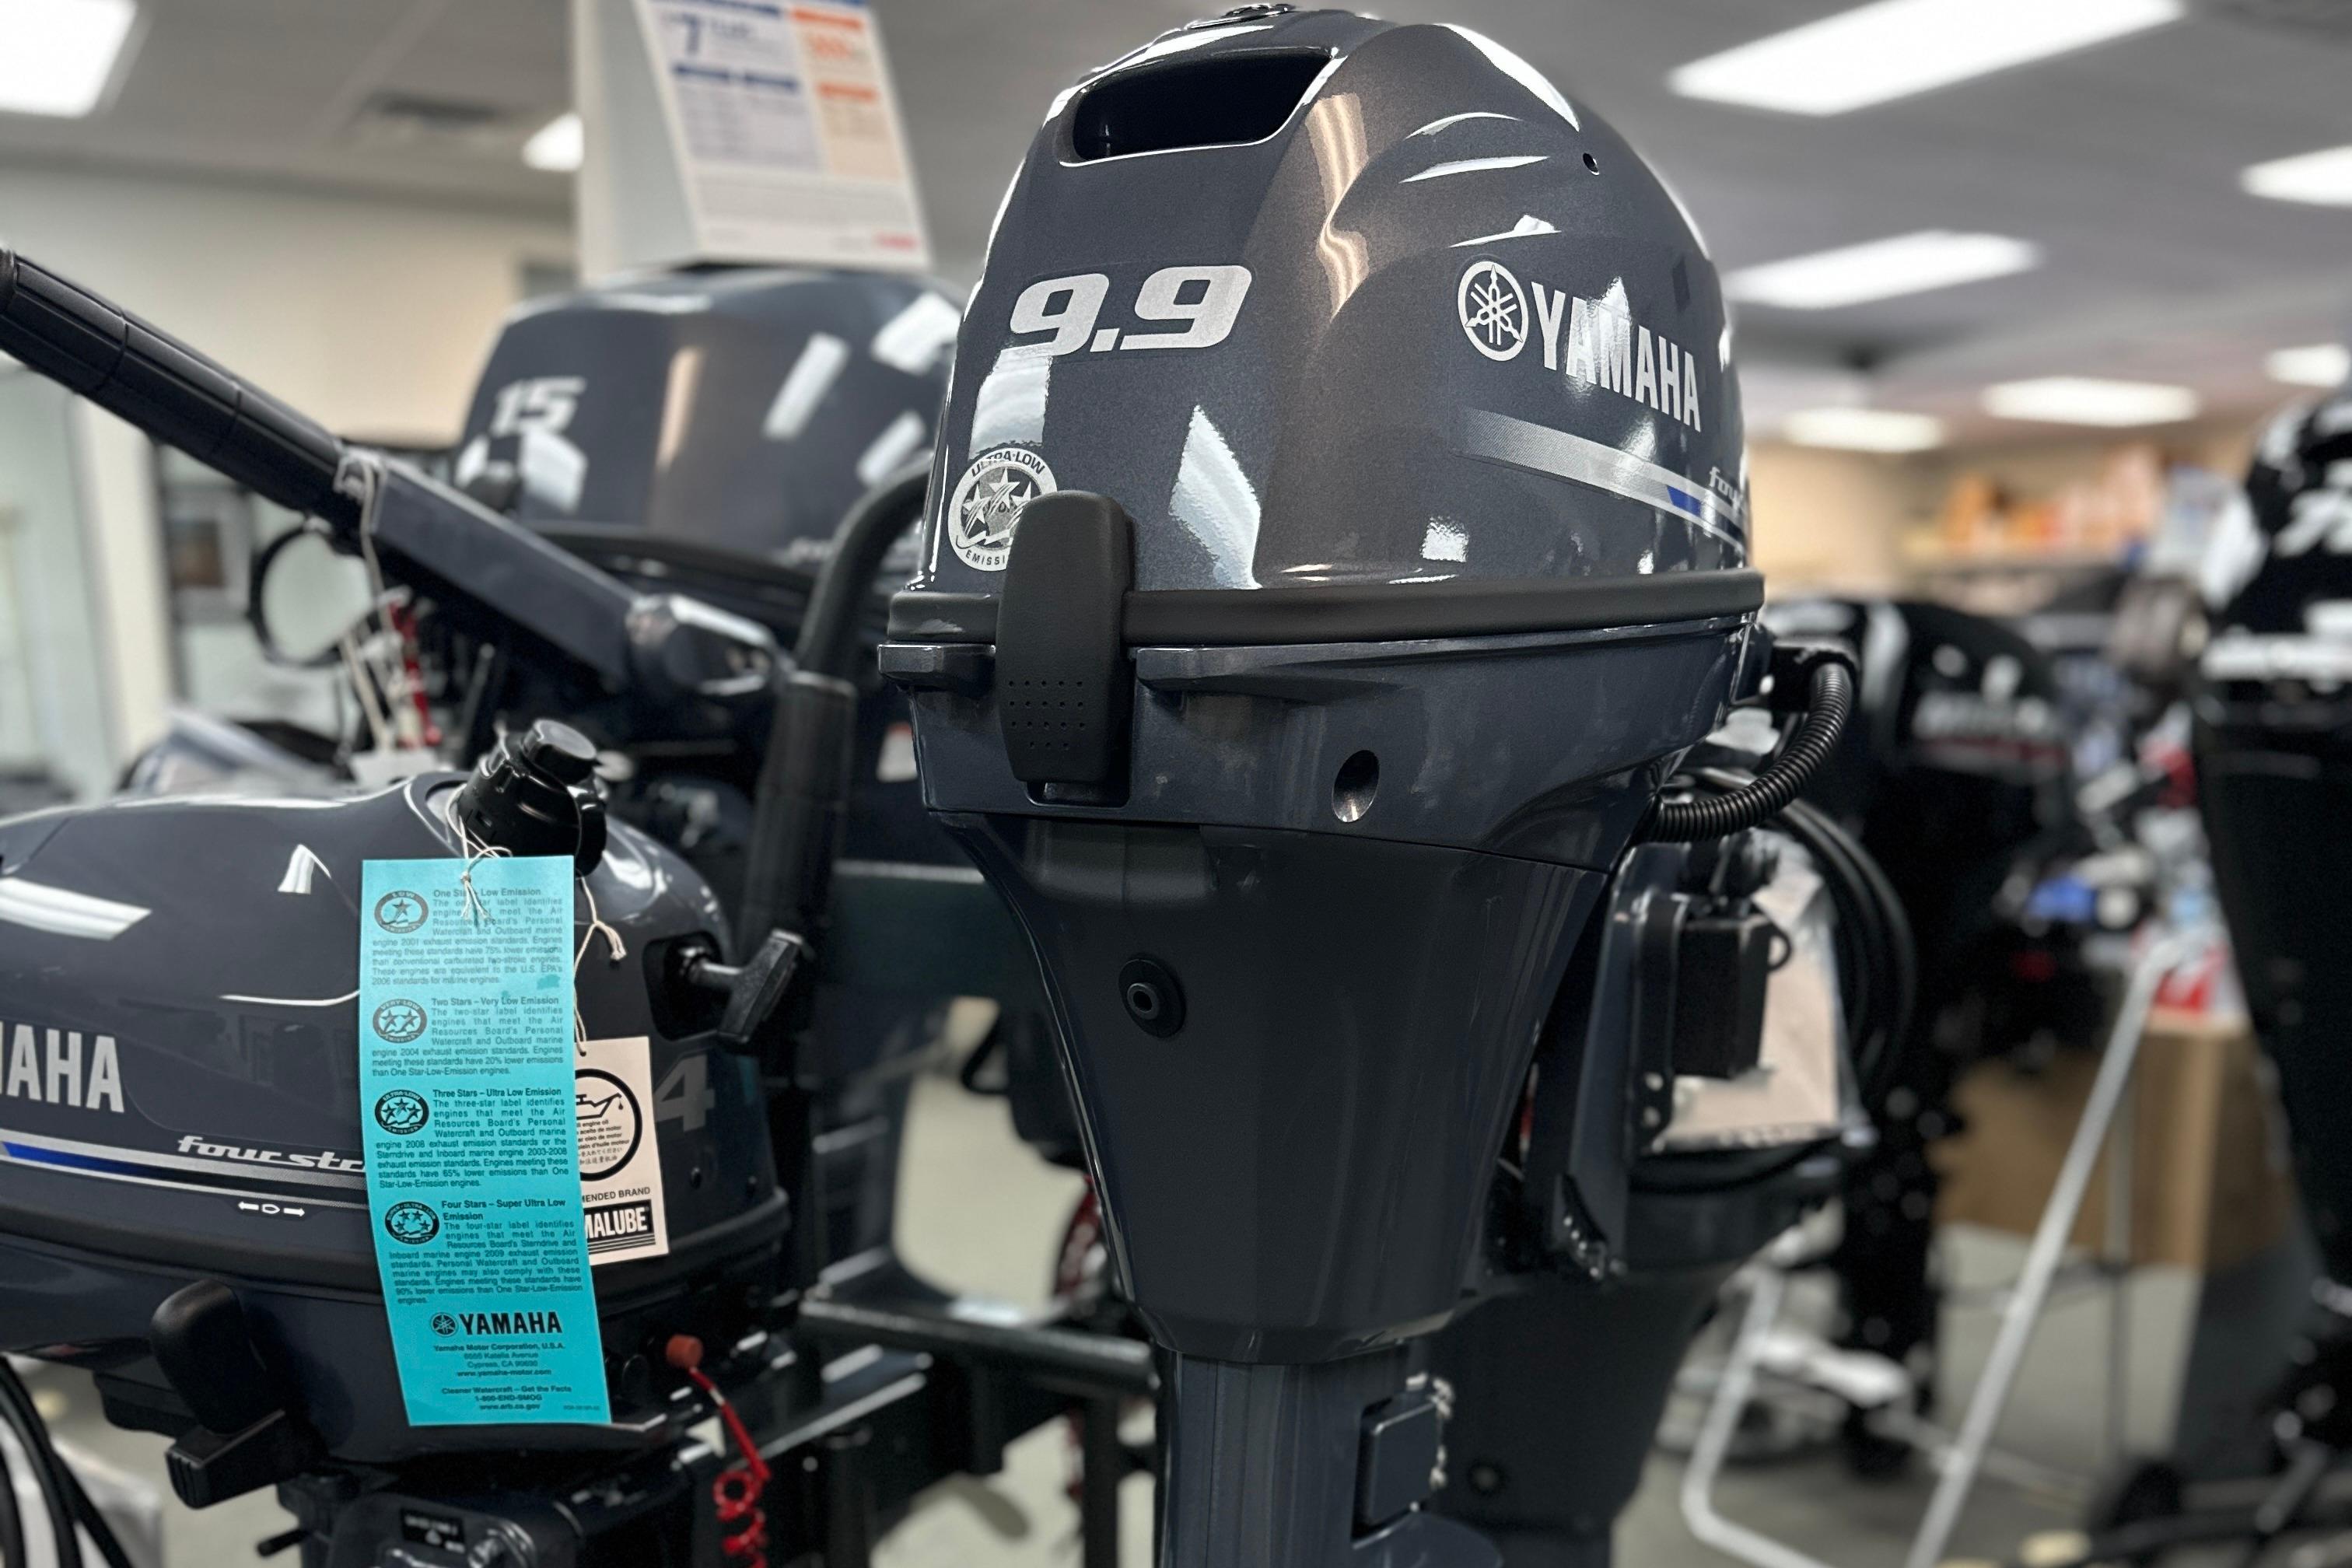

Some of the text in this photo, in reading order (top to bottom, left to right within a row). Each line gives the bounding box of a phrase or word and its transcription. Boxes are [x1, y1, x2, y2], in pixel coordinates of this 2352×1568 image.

[1000, 265, 1252, 356] 9.9
[1531, 282, 1701, 433] YAMAHA
[965, 549, 1006, 566] EMISSI
[0, 1021, 124, 1113] AHA
[653, 1054, 715, 1132] 4
[618, 1187, 651, 1199] BRAND
[458, 1311, 562, 1335] YAMAHA
